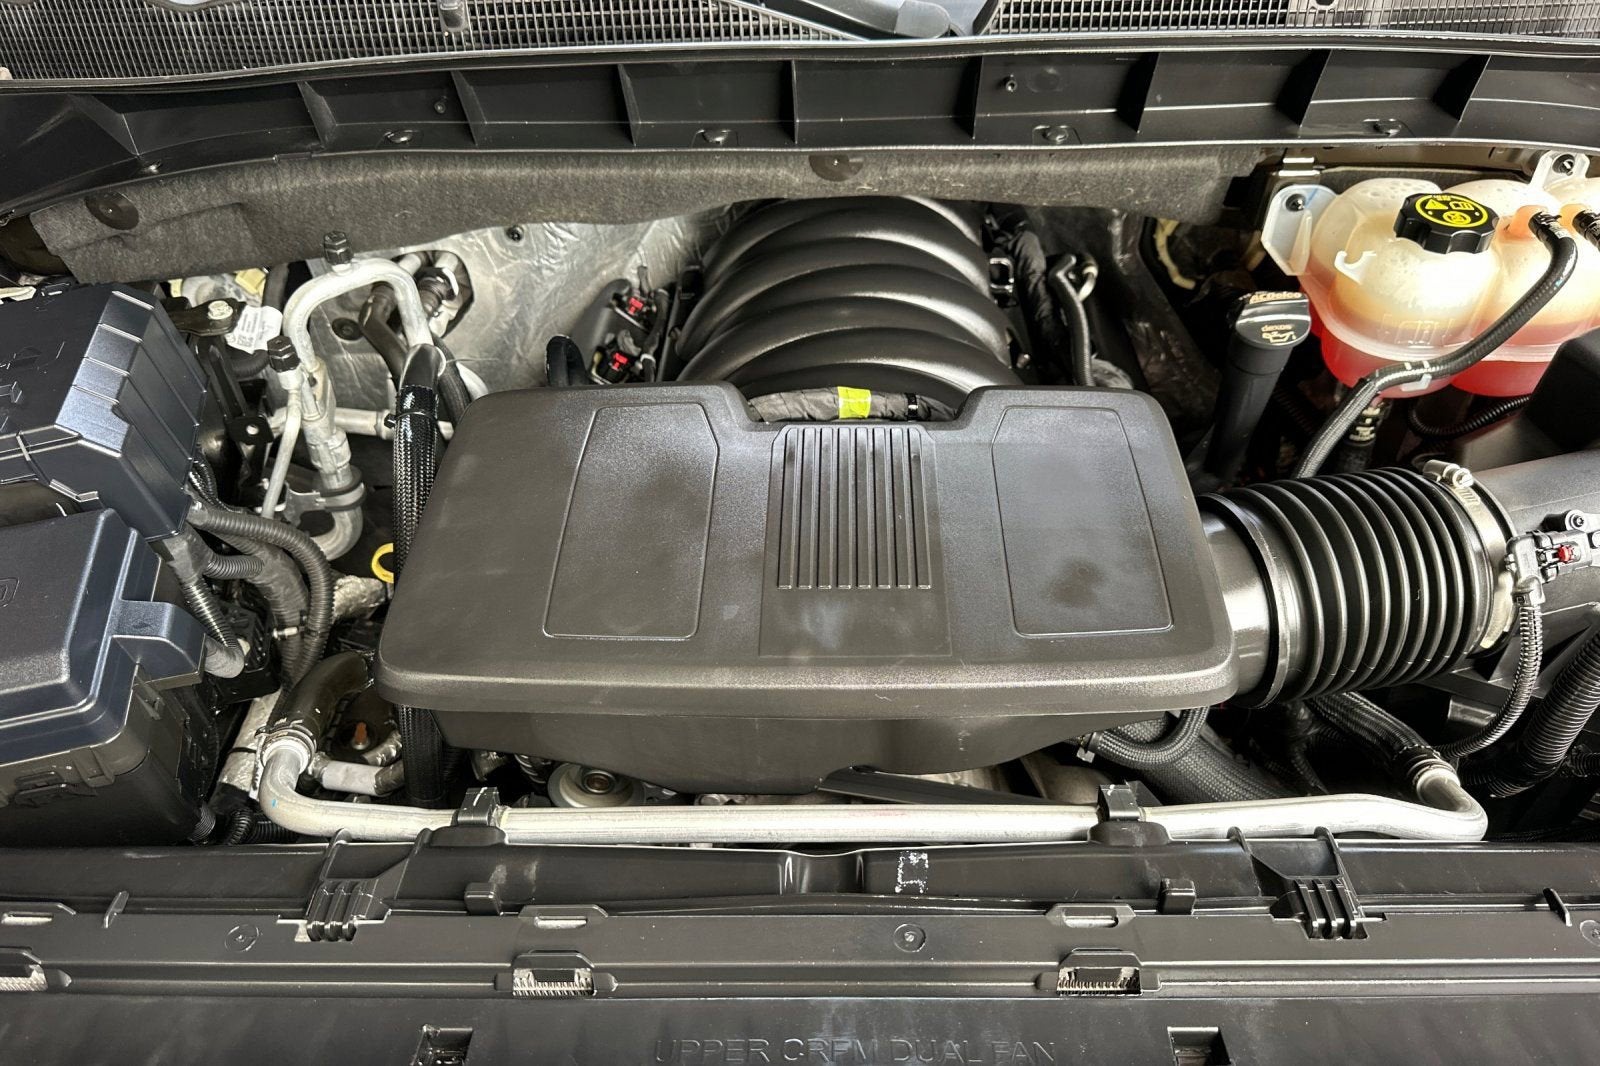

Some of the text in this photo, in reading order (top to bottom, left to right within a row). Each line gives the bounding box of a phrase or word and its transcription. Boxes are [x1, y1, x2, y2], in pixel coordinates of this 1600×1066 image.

[655, 1038, 770, 1063] UPPER
[889, 1038, 983, 1063] DUAL
[991, 1040, 1056, 1064] FAN
